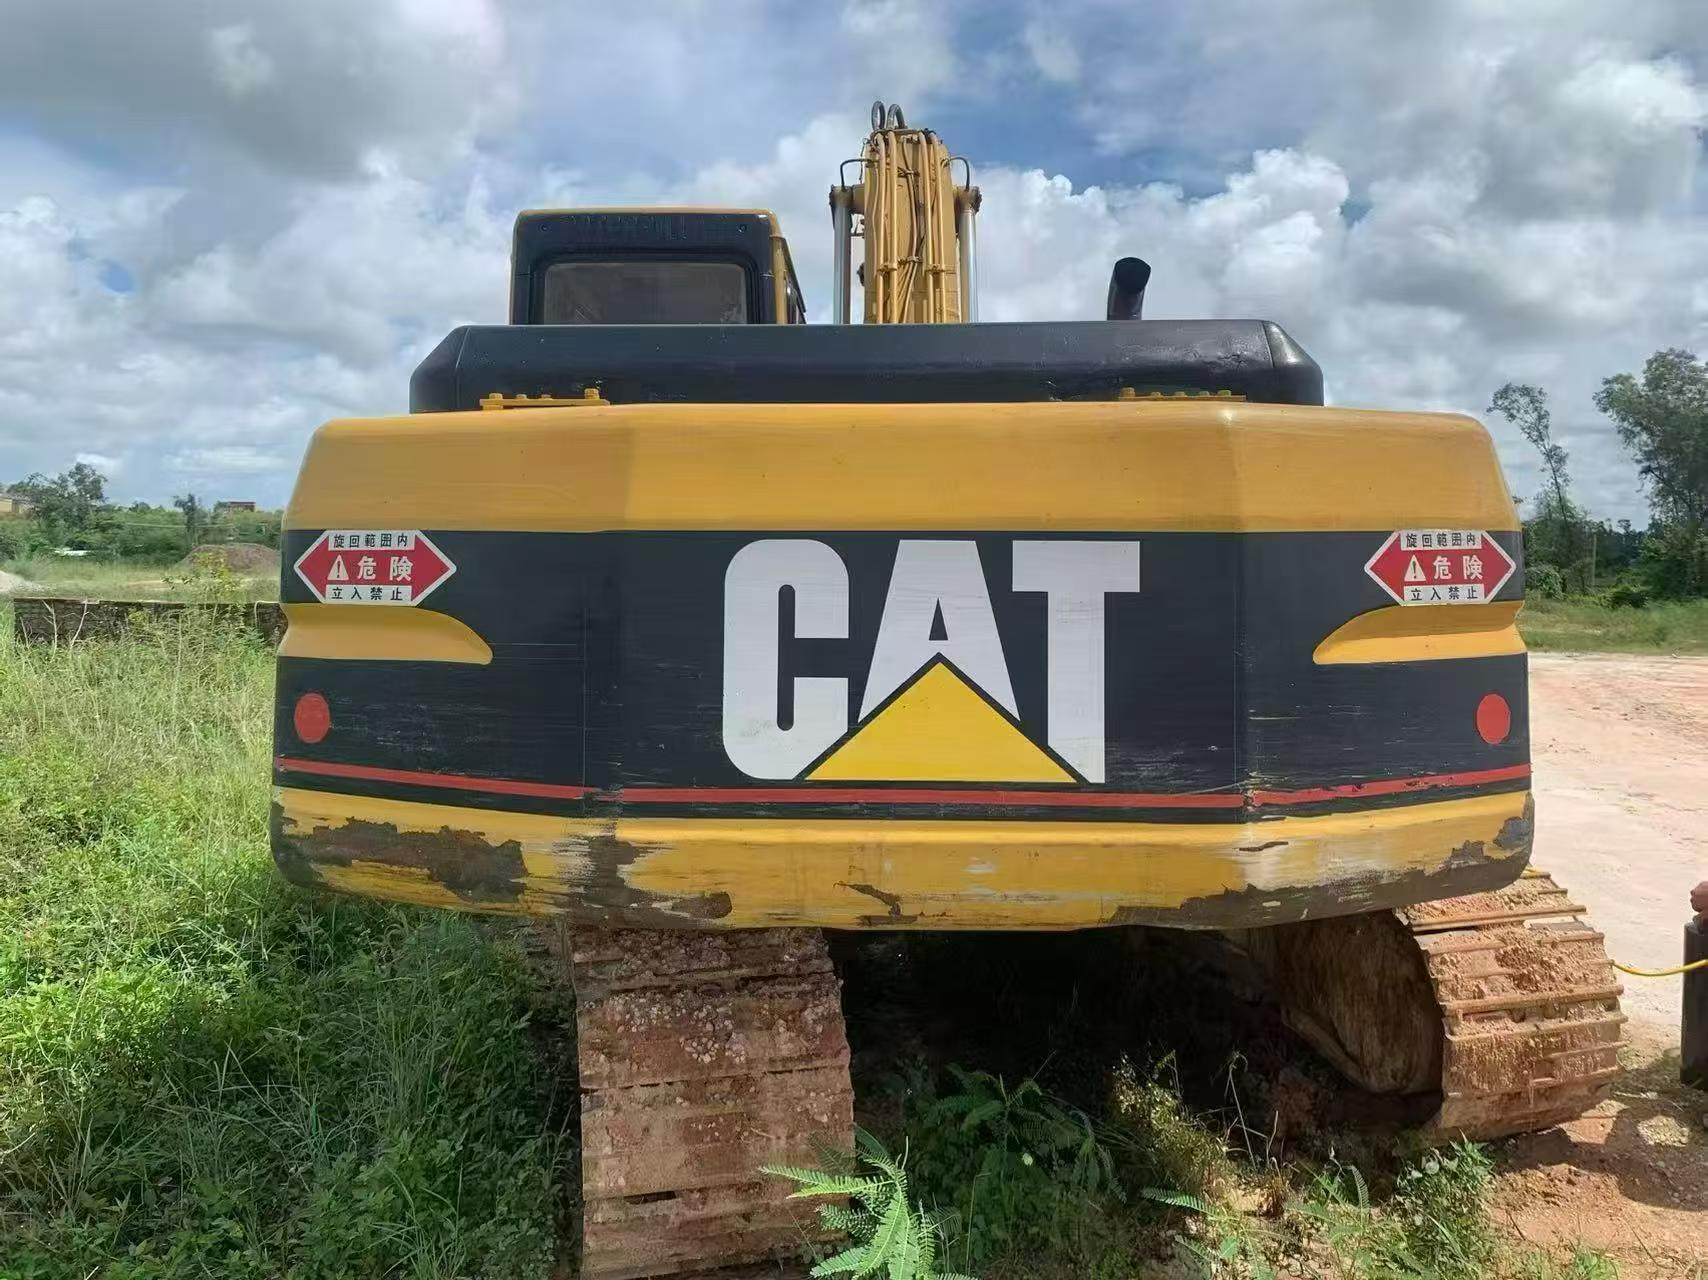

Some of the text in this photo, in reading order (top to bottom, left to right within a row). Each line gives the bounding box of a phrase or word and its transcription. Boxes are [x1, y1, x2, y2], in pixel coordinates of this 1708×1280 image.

[357, 556, 414, 582] 危険
[1432, 555, 1483, 580] 危険
[331, 586, 403, 601] 立入禁止
[1410, 586, 1478, 601] 立入禁止
[722, 539, 1140, 784] CAT
